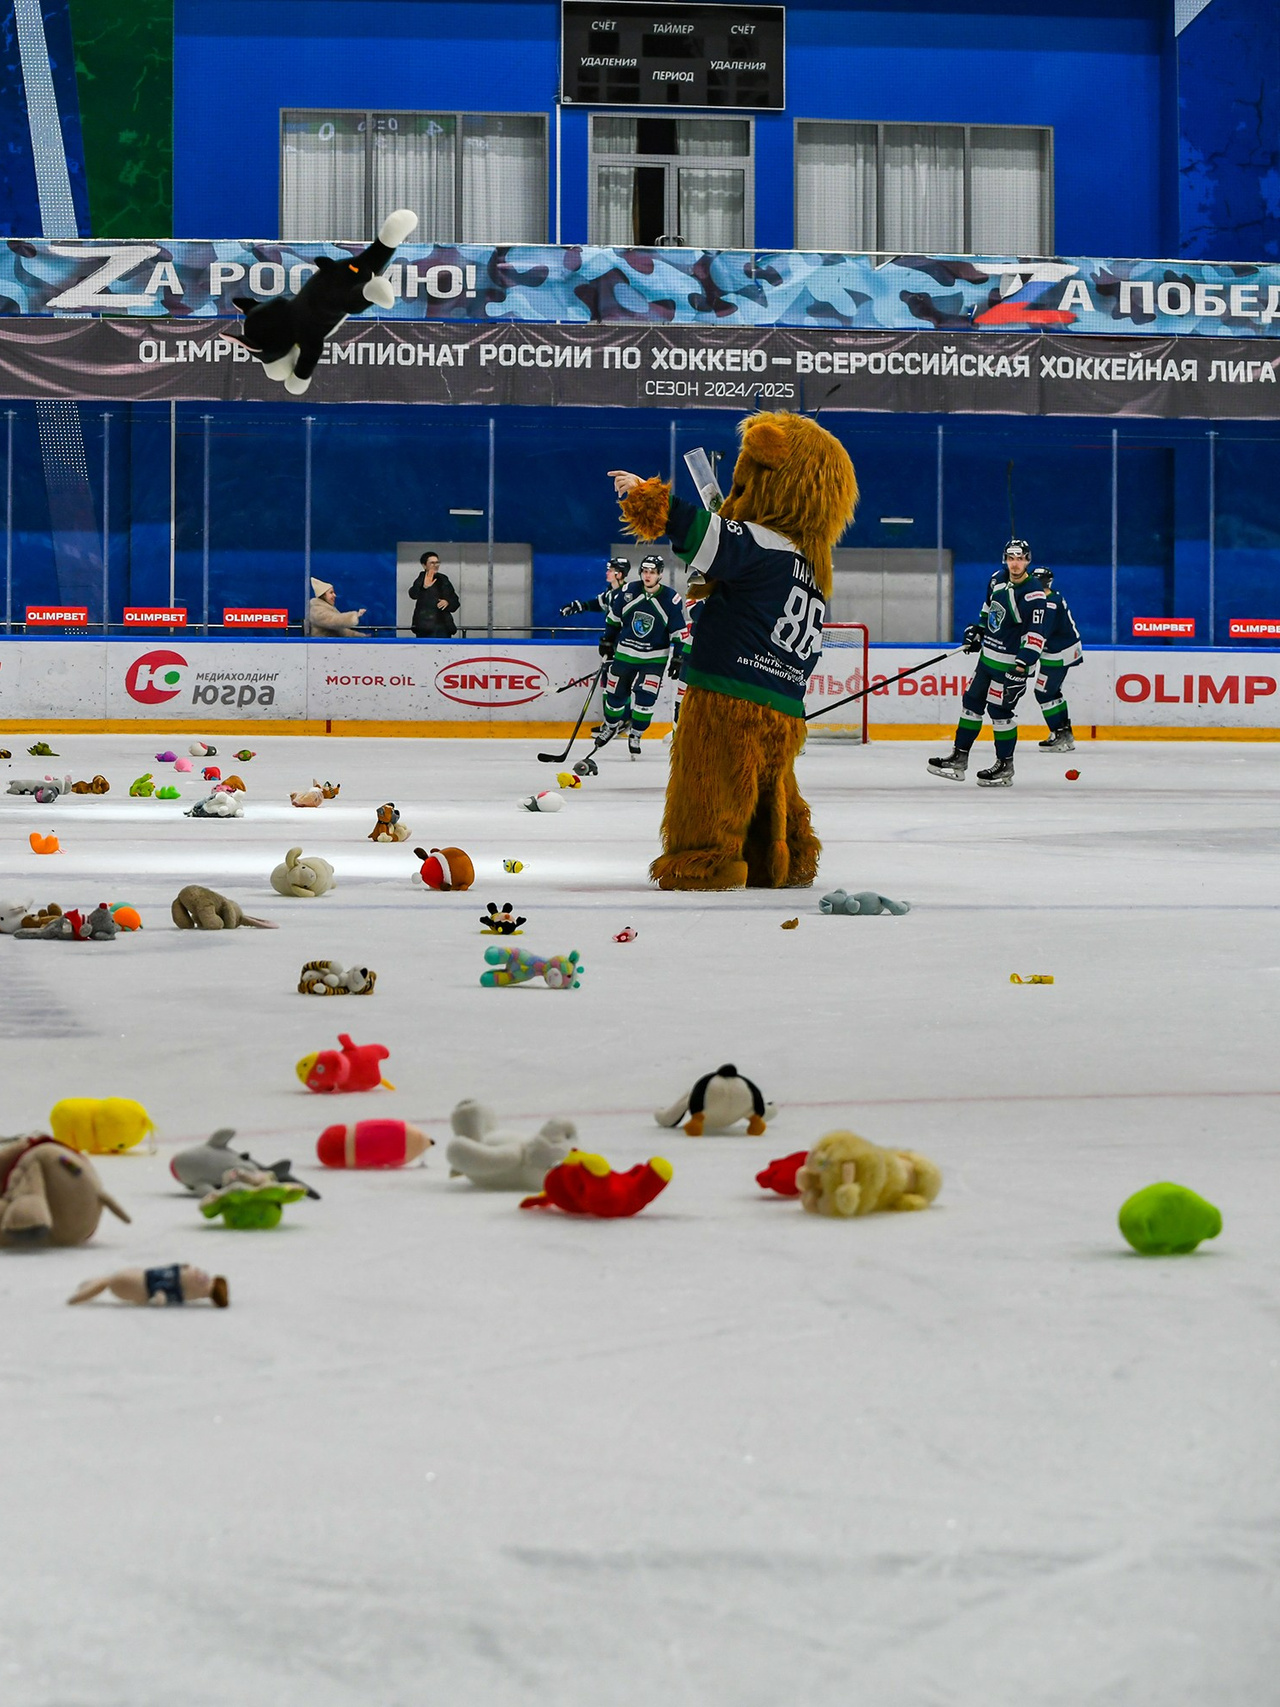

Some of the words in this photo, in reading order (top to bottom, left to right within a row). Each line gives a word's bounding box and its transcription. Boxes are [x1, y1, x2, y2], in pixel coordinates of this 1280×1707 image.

[591, 19, 617, 31] СЧЁТ
[653, 22, 695, 34] ТАЙМЕР
[730, 23, 756, 35] СЧЁТ
[580, 57, 638, 67] УДАЛЕНИЯ
[710, 60, 767, 71] УДАЛЕНИЯ
[652, 71, 695, 83] ПЕРИОД
[209, 261, 477, 299] РОСИЮ!
[316, 342, 470, 367] ЕМПИОНАТ
[479, 343, 592, 369] РОССИИ
[603, 346, 642, 370] ПО
[796, 346, 1030, 378] ВСЕРОССИЙСКАЯ
[1039, 352, 1198, 383] ХОККЕЙНАЯ
[1207, 359, 1278, 384] ЛИГА
[644, 381, 699, 397] СЕЗОН
[704, 382, 795, 399] 2024/2025
[27, 611, 86, 621] OLIMPBET
[125, 612, 186, 623] OLIMPBET
[224, 613, 286, 623] OLIMPBET
[1032, 608, 1046, 625] 67
[770, 585, 826, 661] 86
[1133, 622, 1193, 633] OLIMPBET
[195, 672, 280, 683] МЕДИАХОЛДИНГ
[326, 675, 384, 686] MOTOR
[389, 675, 416, 687] OIL
[443, 674, 541, 690] SINTEC
[806, 667, 890, 703] льфа
[1115, 673, 1278, 705] OLIMP
